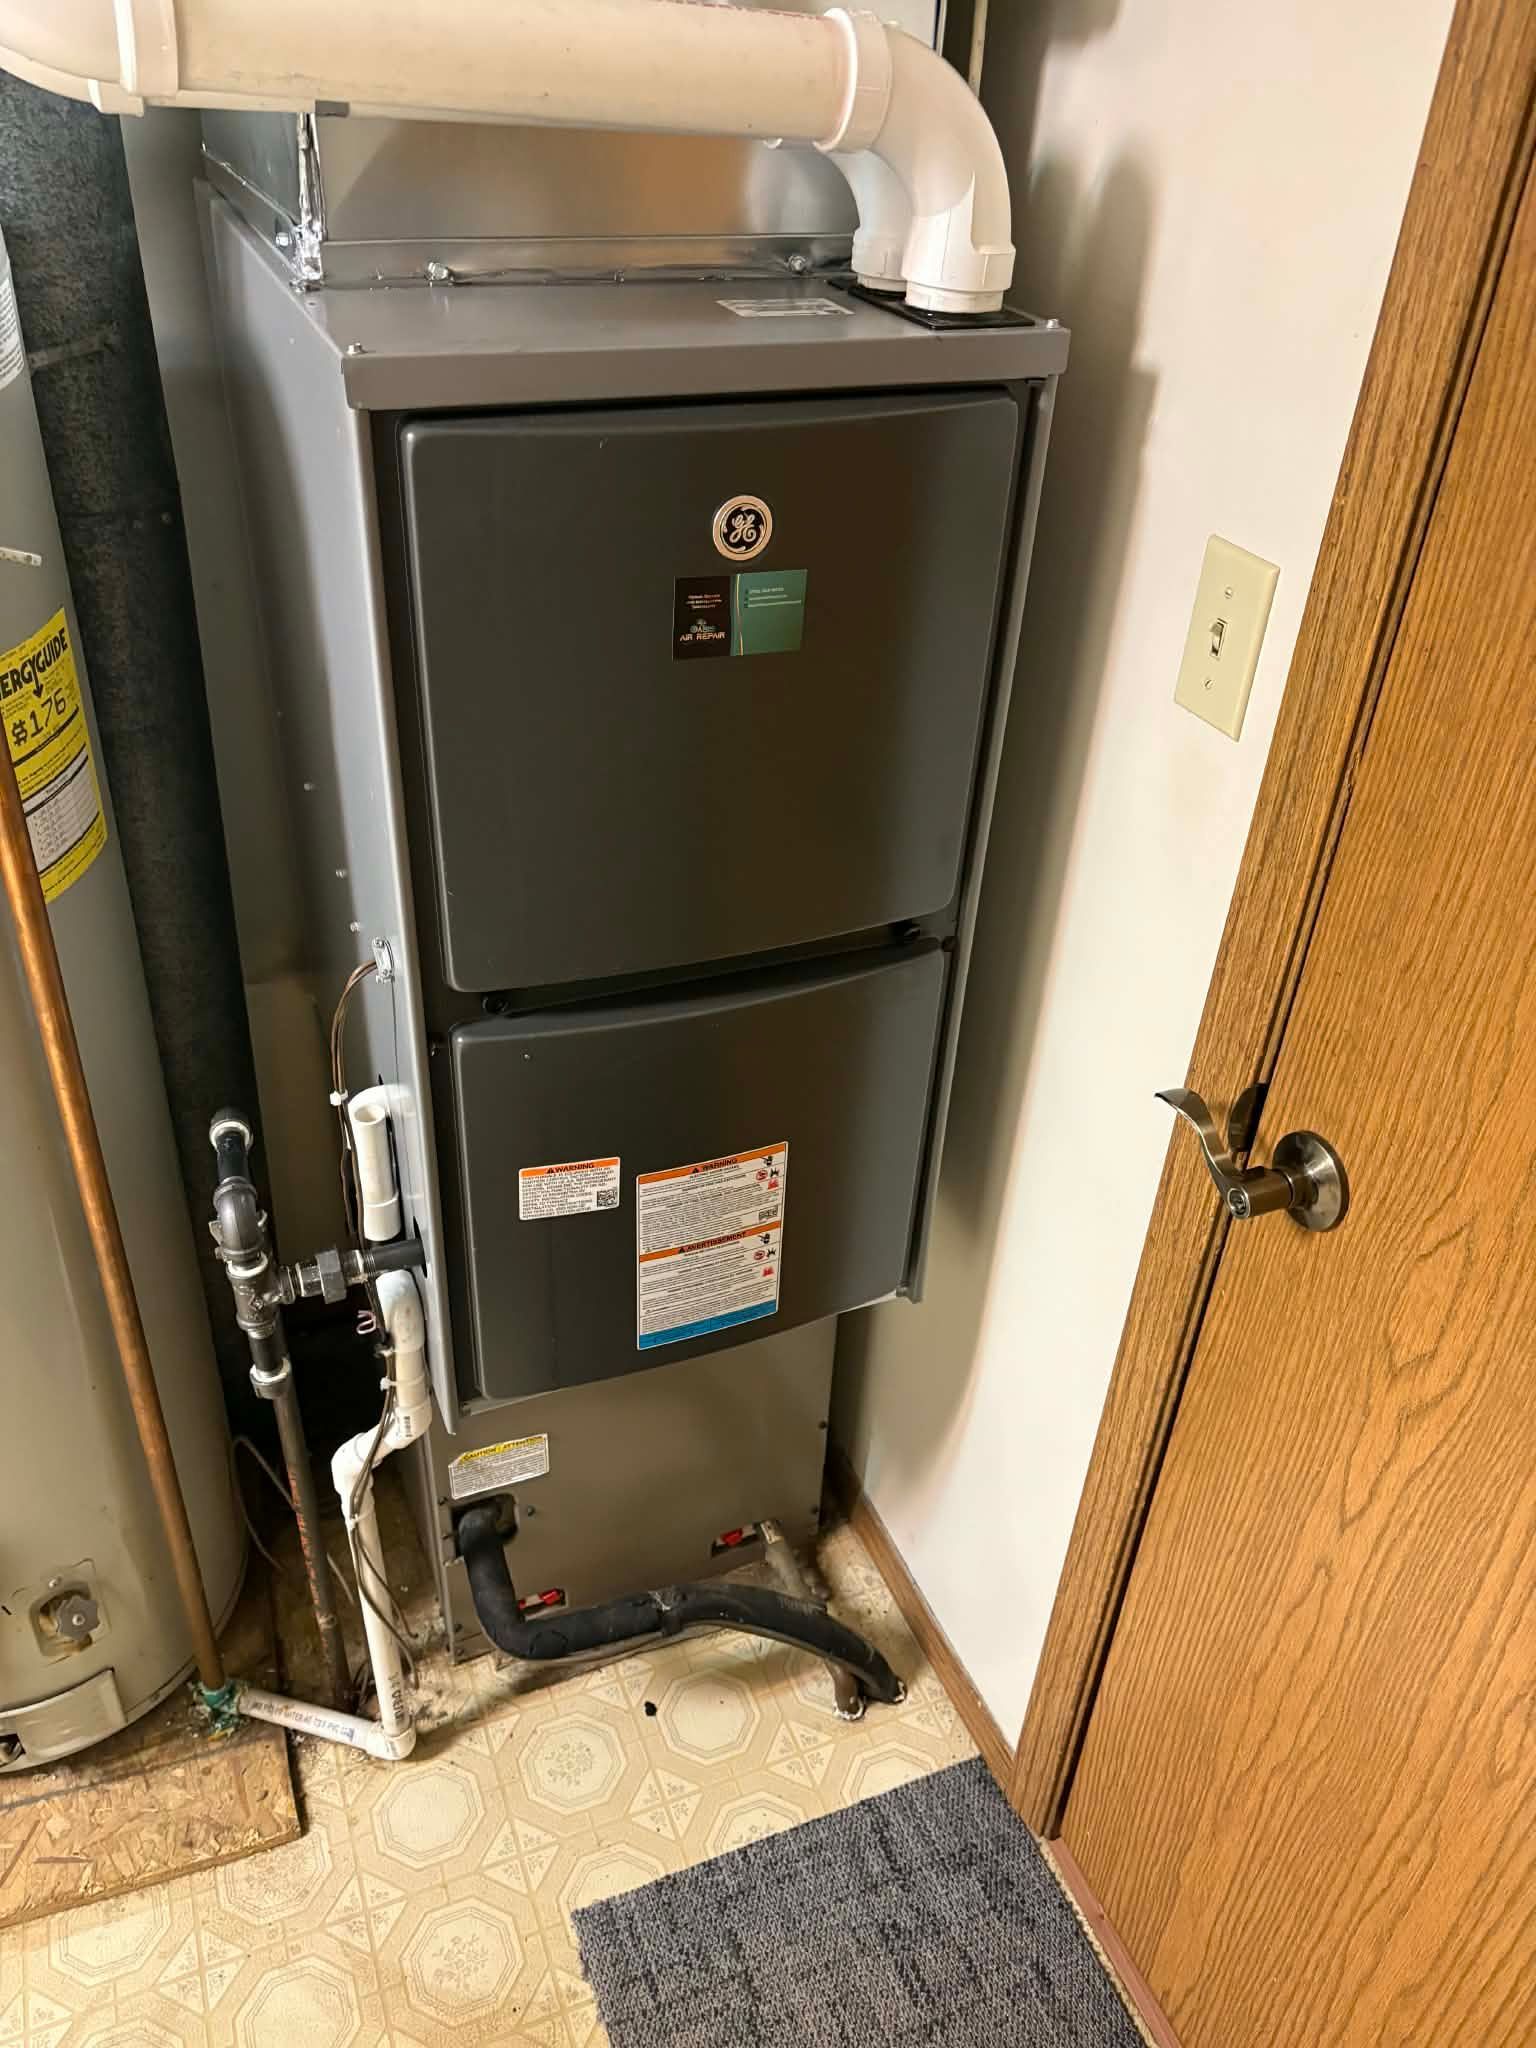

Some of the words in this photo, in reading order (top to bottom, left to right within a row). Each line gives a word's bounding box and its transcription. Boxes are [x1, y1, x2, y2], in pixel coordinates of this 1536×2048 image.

[679, 633, 693, 642] AIR
[696, 631, 726, 641] REPAIR
[555, 1162, 594, 1174] WARNING
[702, 1158, 738, 1172] WARNING
[687, 1231, 746, 1251] AVERTISSEMENT
